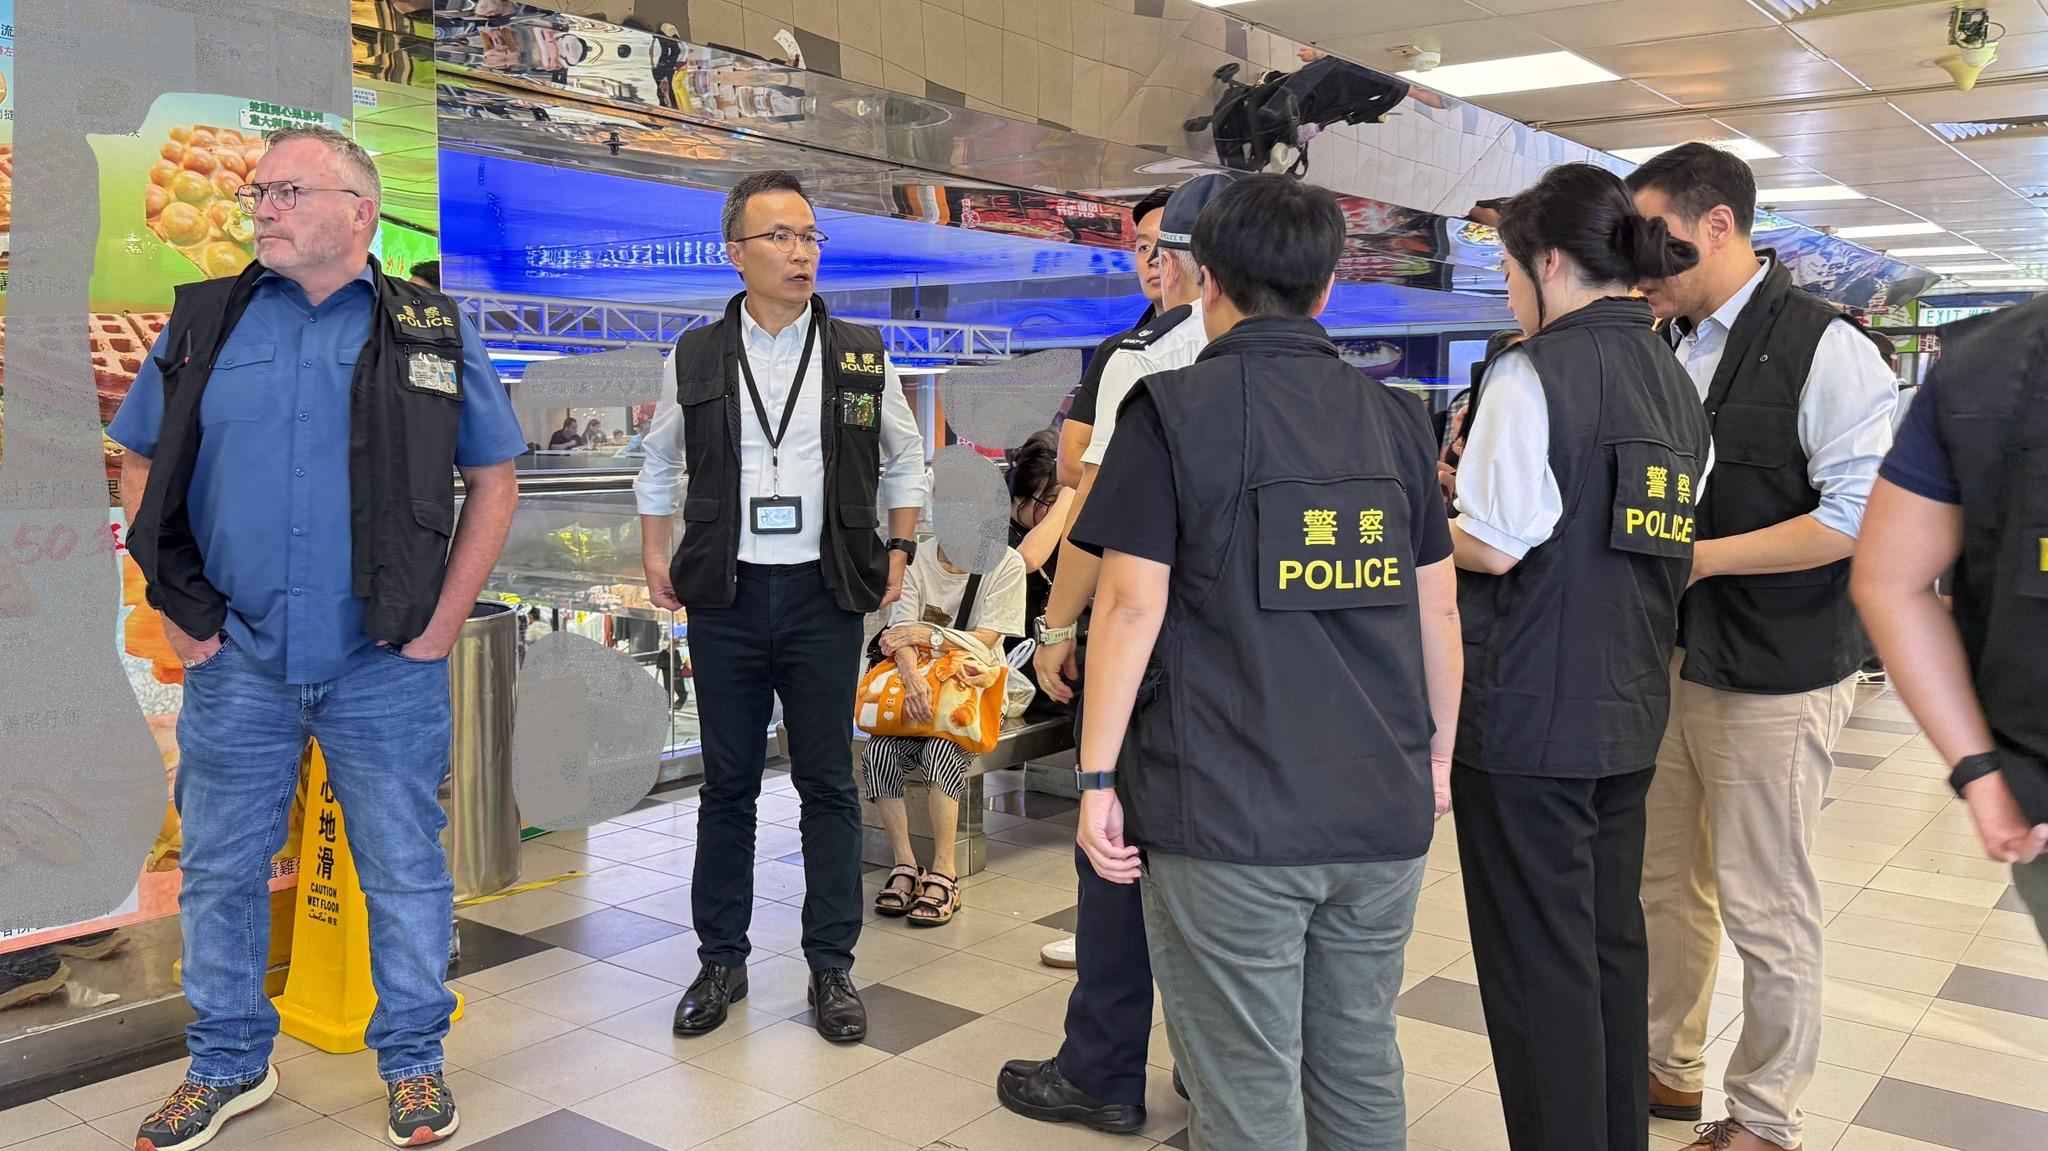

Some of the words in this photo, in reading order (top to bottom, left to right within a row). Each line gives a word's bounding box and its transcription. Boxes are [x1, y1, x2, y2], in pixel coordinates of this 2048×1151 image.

[396, 313, 454, 328] POLICE
[1926, 309, 1963, 324] EXIT
[845, 352, 875, 364] 警察
[840, 361, 884, 374] POLICE
[1645, 465, 1692, 504] 警察
[1303, 508, 1385, 546] 警察
[1626, 508, 1694, 543] POLICE
[1278, 556, 1402, 591] POLICE
[310, 882, 338, 899] CAUTION
[307, 895, 320, 908] WET
[320, 898, 340, 914] FLOOR
